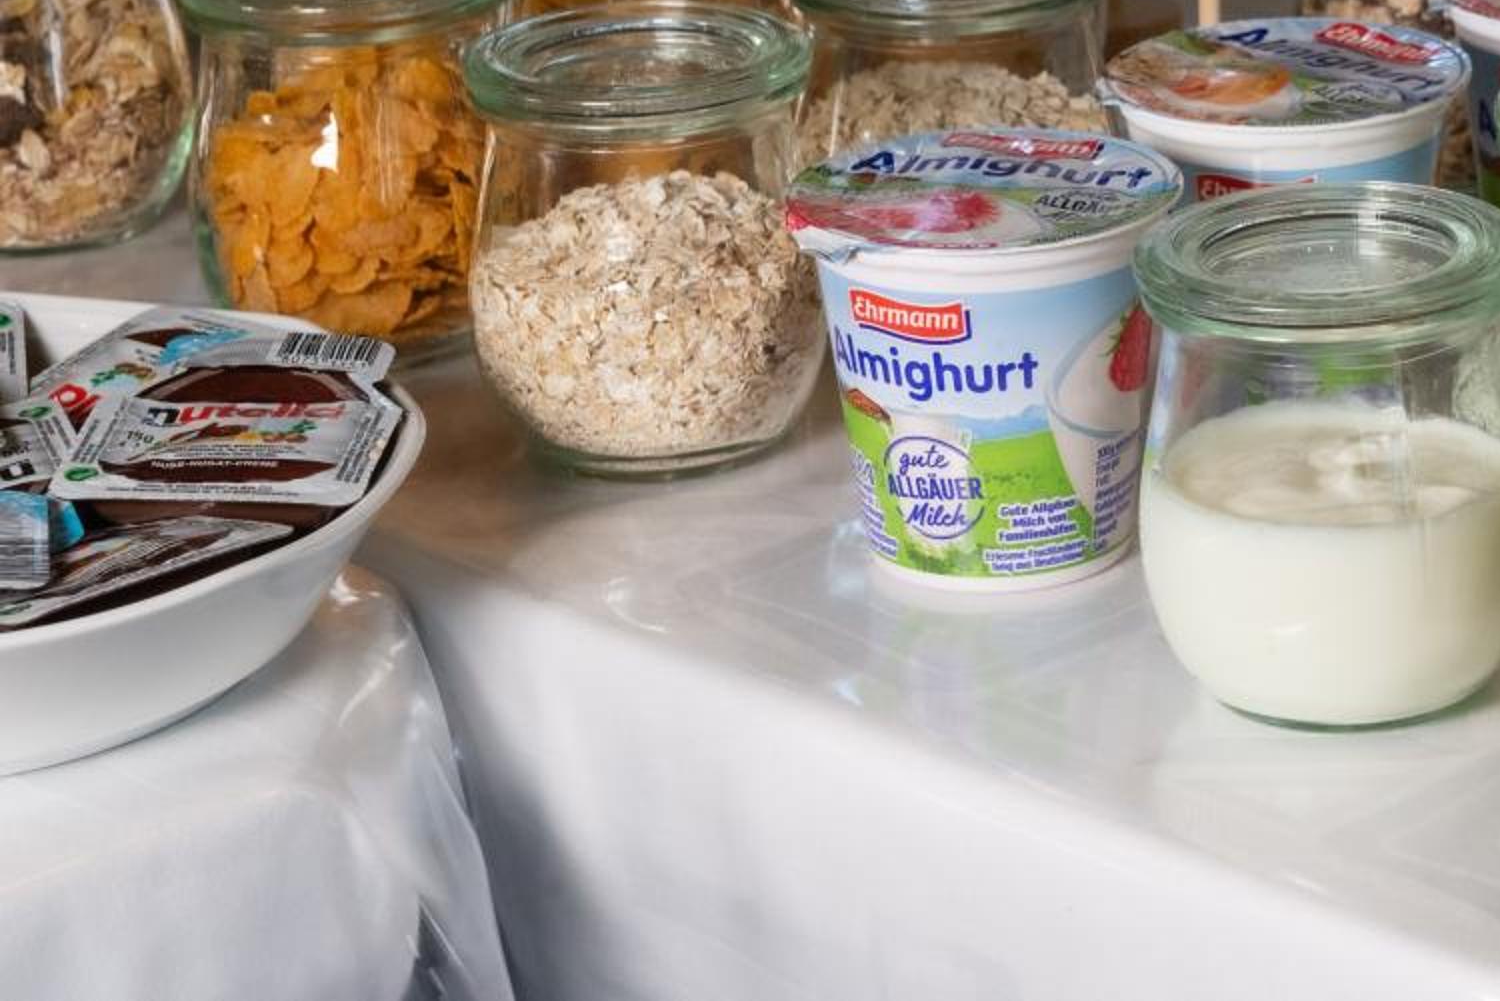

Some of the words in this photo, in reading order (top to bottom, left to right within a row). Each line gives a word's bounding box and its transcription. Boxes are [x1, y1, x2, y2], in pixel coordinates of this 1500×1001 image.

[851, 151, 1153, 189] Almighurt
[854, 297, 959, 330] Ehrmann
[834, 325, 1039, 402] Almighurt
[900, 445, 949, 475] gute
[888, 473, 985, 500] ALLGÄUER
[906, 502, 970, 526] Milch
